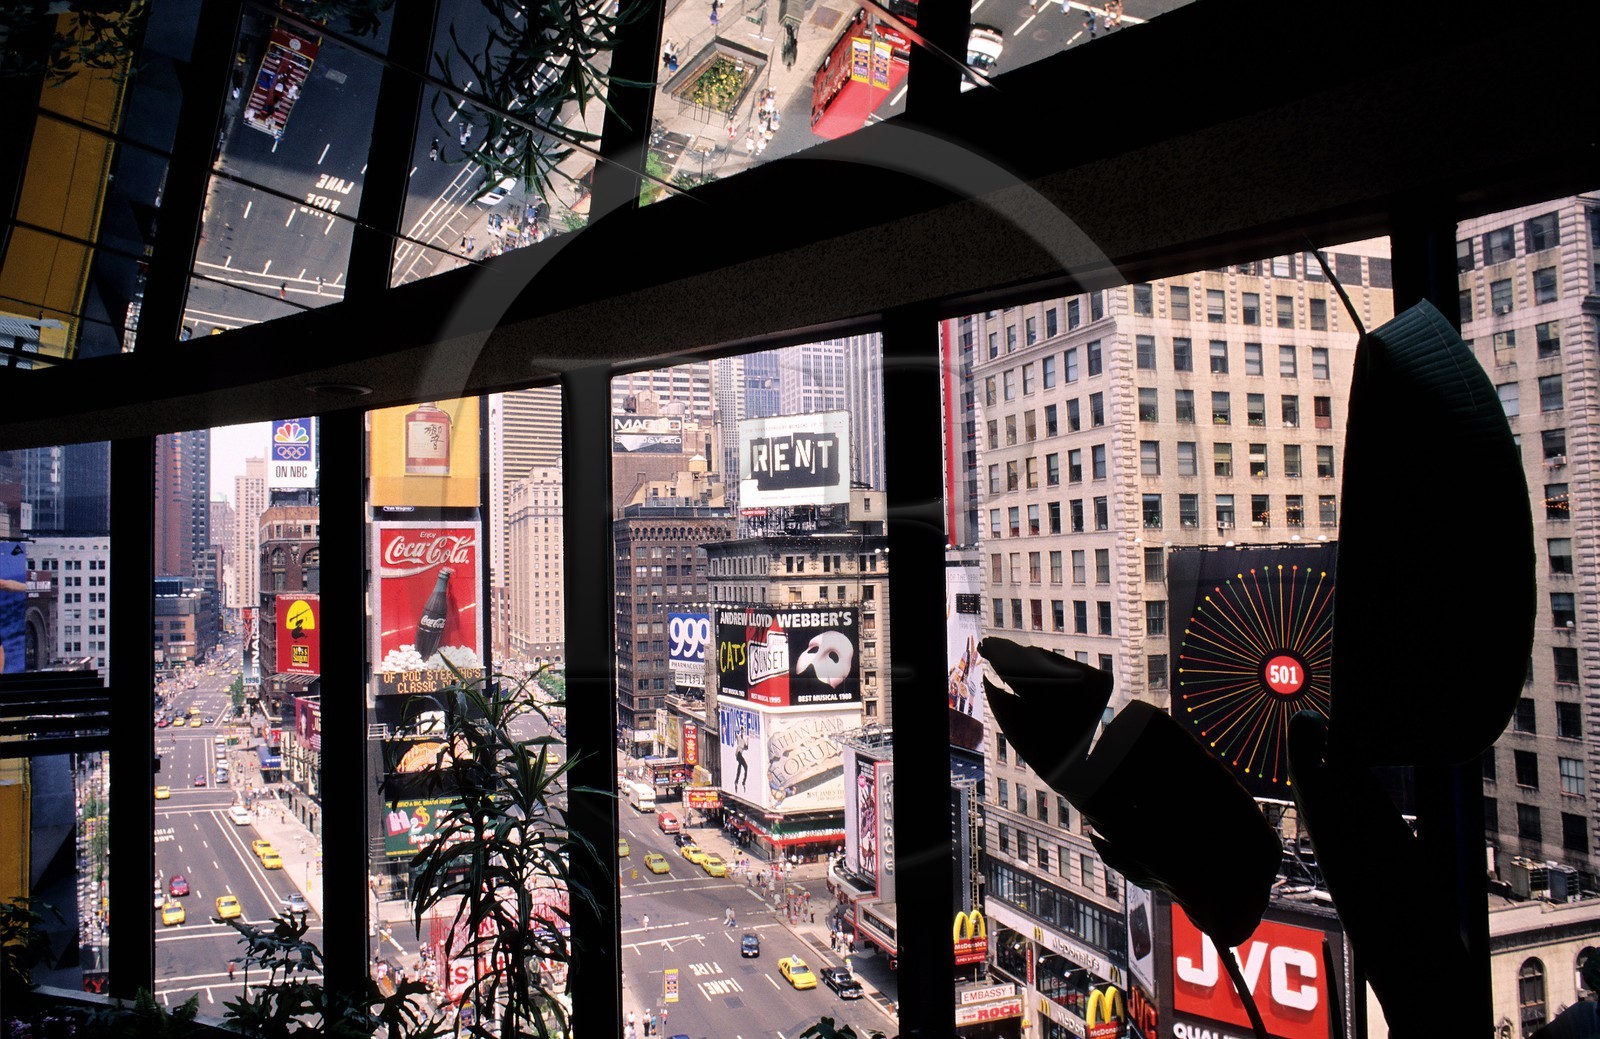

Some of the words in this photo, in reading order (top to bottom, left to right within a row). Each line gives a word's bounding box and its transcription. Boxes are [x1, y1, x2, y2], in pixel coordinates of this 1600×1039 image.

[752, 438, 833, 474] RENT
[275, 465, 288, 478] ON
[290, 465, 308, 478] NBC
[420, 531, 437, 539] Enjoy
[384, 536, 470, 565] Coca-Cola
[420, 614, 447, 630] Coca-Cola
[720, 611, 748, 625] ANDREW
[748, 613, 773, 628] LLOYD
[776, 611, 853, 629] WEBBER'S
[670, 617, 710, 659] 999
[251, 632, 260, 677] FINAL
[720, 641, 746, 673] CATS
[752, 650, 784, 674] SUNSET
[427, 668, 481, 681] STERLNG'S
[1270, 664, 1298, 685] 501
[397, 681, 437, 694] CLASSIC
[812, 692, 838, 701] MUSICAL
[772, 741, 844, 784] FORUM
[883, 773, 893, 871] PALACE
[1051, 937, 1100, 972] McDonald's
[1177, 932, 1319, 1012] JVC
[963, 988, 1007, 1002] EMBASSY
[1009, 986, 1014, 996] 1
[977, 1003, 1021, 1021] ROCK
[1127, 985, 1157, 1039] JVC
